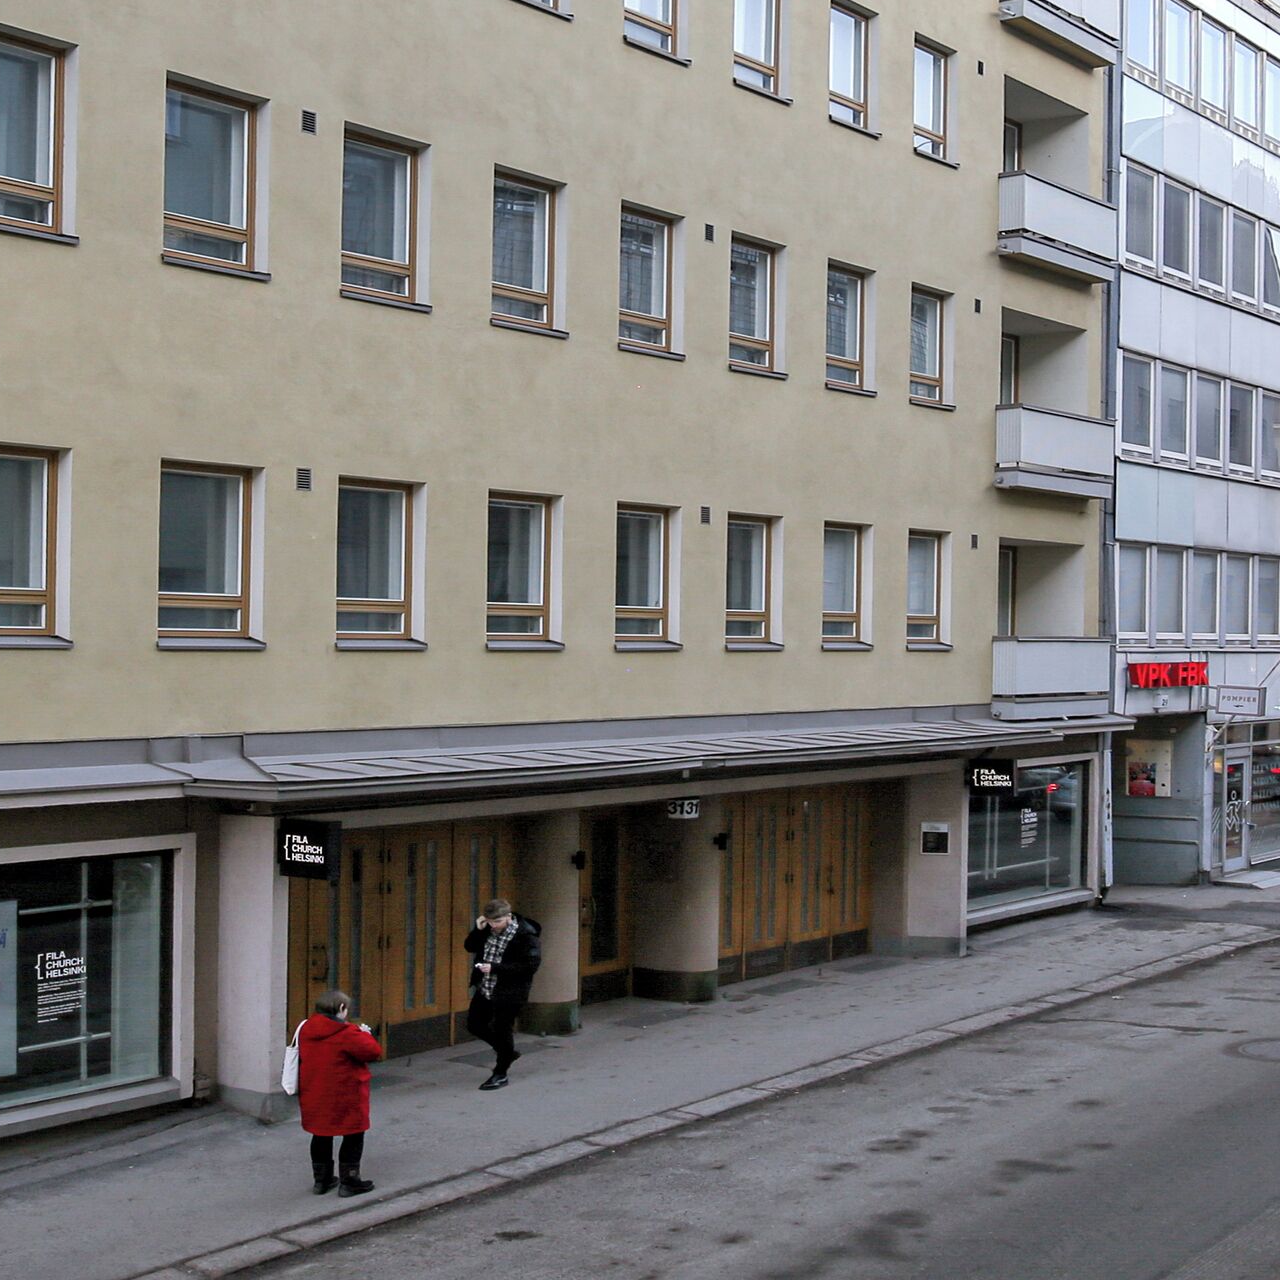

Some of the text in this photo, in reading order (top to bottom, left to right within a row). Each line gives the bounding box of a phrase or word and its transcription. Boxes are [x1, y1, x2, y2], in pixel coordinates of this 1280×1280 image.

[292, 834, 308, 844] FILA
[291, 843, 323, 855] CHURCH
[291, 853, 325, 864] HELSINKI
[45, 951, 66, 960] FILA
[45, 957, 84, 970] CHURCH
[45, 965, 87, 979] HELSINKI
